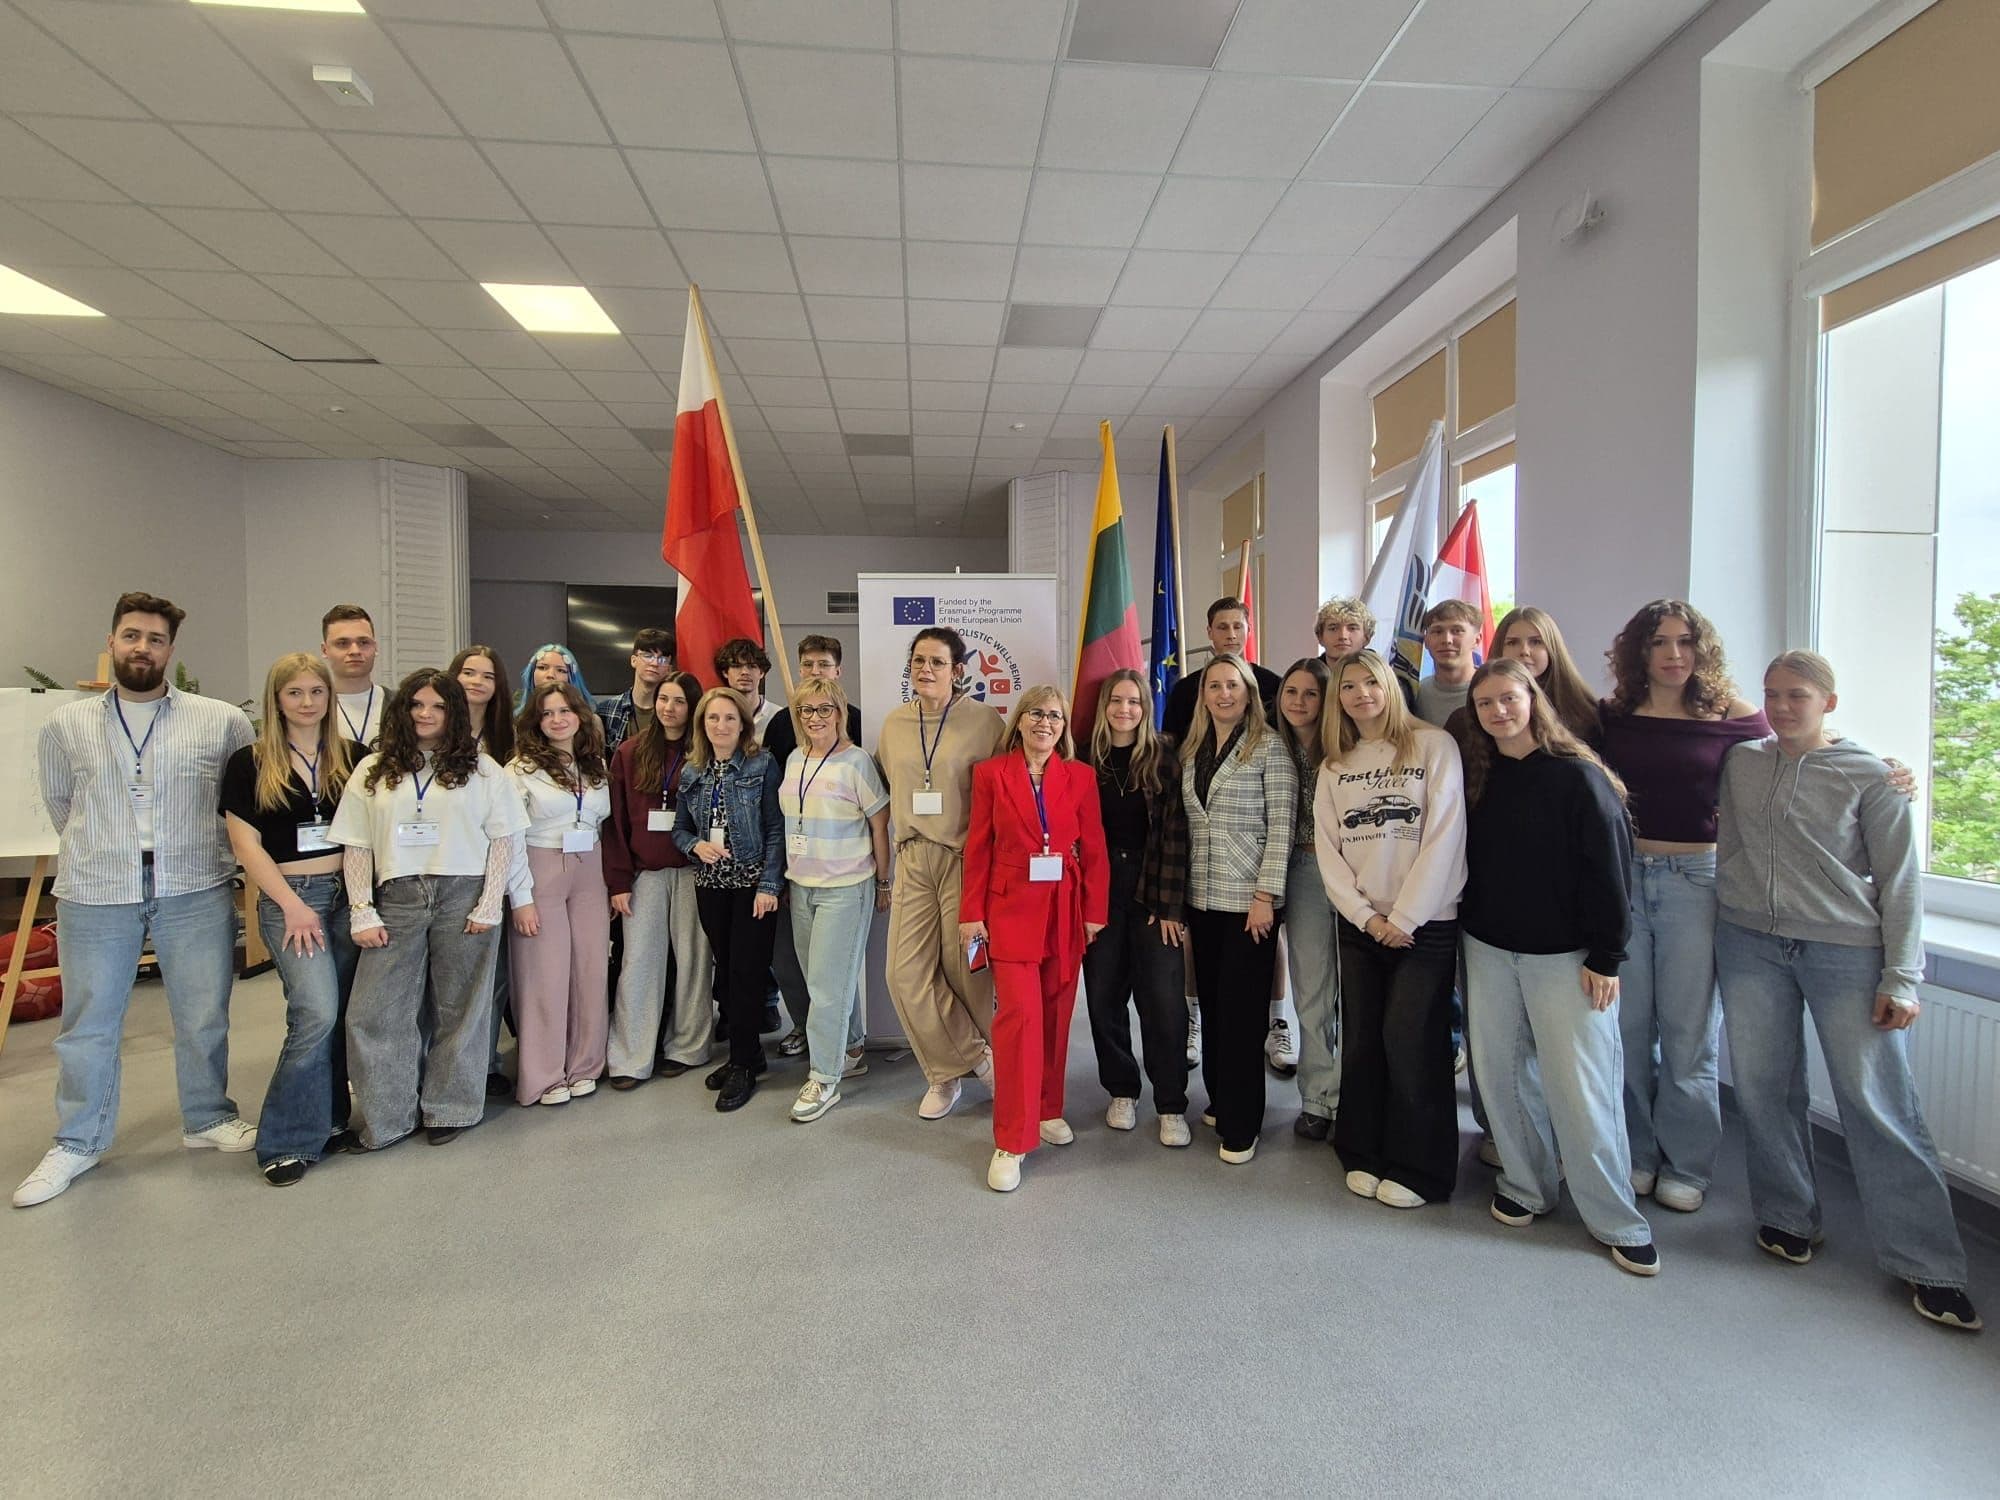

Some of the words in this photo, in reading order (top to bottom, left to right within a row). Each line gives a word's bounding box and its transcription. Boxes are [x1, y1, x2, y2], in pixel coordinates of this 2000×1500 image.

[938, 597, 967, 606] Funded
[969, 598, 978, 607] by
[980, 598, 992, 606] the
[938, 607, 976, 615] Erasmus+
[978, 607, 1022, 616] Programme
[938, 616, 947, 624] of
[948, 616, 960, 624] the
[962, 616, 998, 625] European
[1000, 616, 1022, 624] Union
[901, 679, 911, 704] DING
[953, 628, 994, 645] OLISTIC
[993, 640, 1022, 691] WELL-BEING
[1338, 771, 1372, 786] Fast
